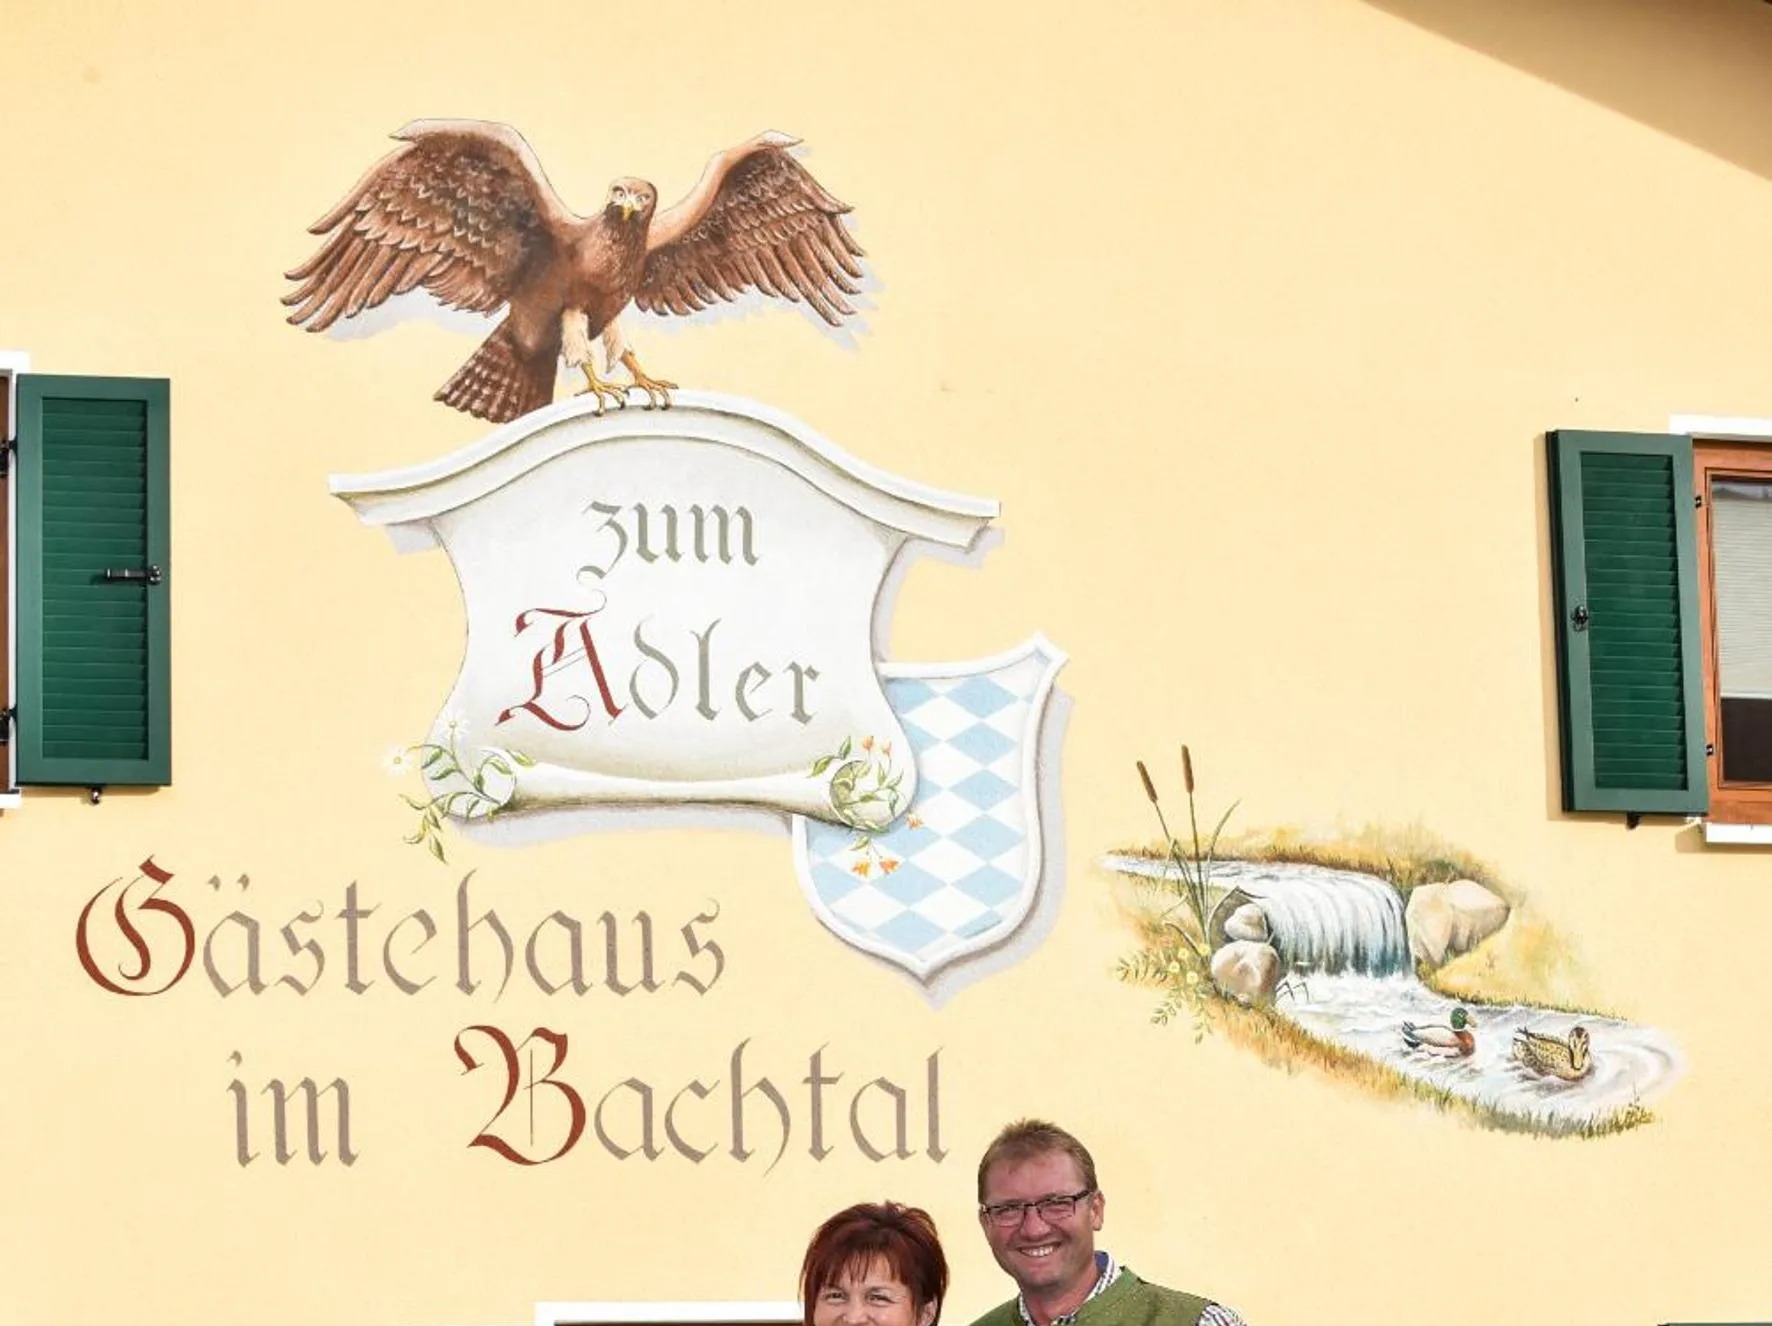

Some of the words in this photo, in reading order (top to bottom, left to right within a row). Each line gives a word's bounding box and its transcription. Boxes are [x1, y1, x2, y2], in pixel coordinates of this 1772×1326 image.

[576, 500, 759, 586] zum
[494, 588, 822, 731] Adler
[75, 854, 727, 1004] Gästehaus
[226, 1050, 359, 1168] im
[454, 1025, 951, 1179] Bachtal
